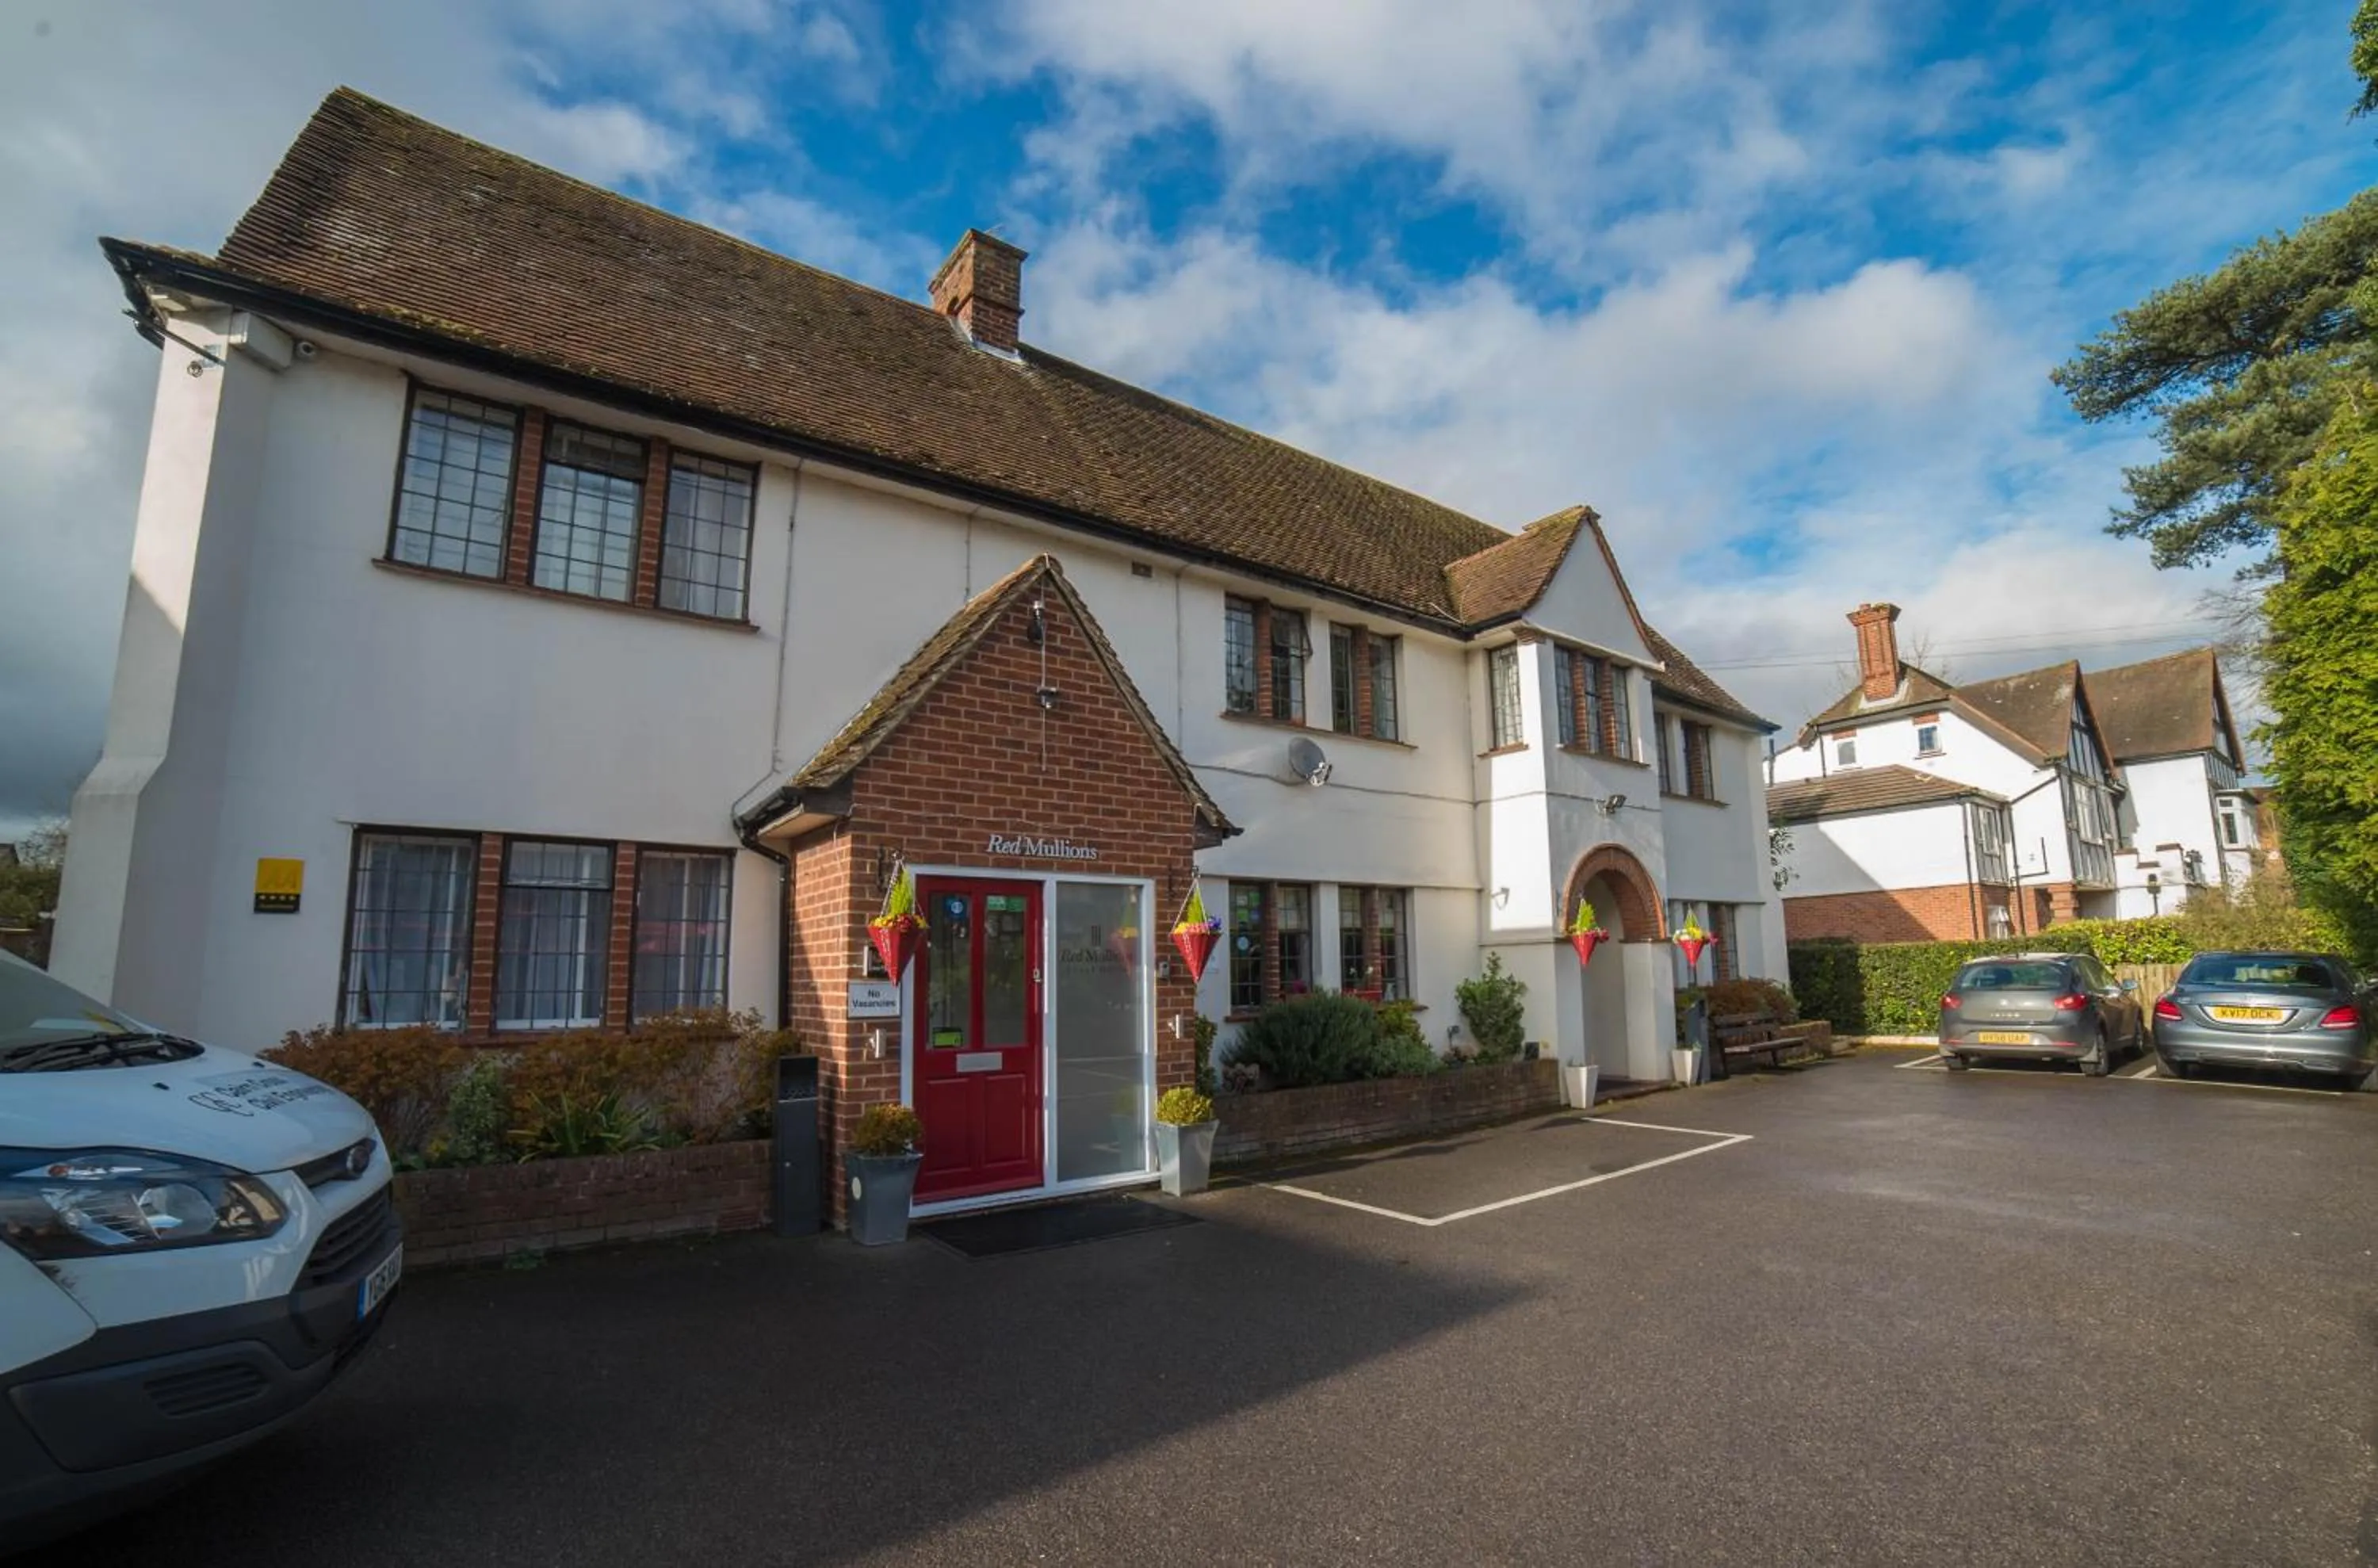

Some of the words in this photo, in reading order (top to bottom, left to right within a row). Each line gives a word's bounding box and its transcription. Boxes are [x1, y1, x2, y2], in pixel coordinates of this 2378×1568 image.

[985, 833, 1022, 855] Red
[1023, 836, 1098, 859] Mullions
[868, 989, 881, 998] No
[852, 999, 897, 1008] Vacancies
